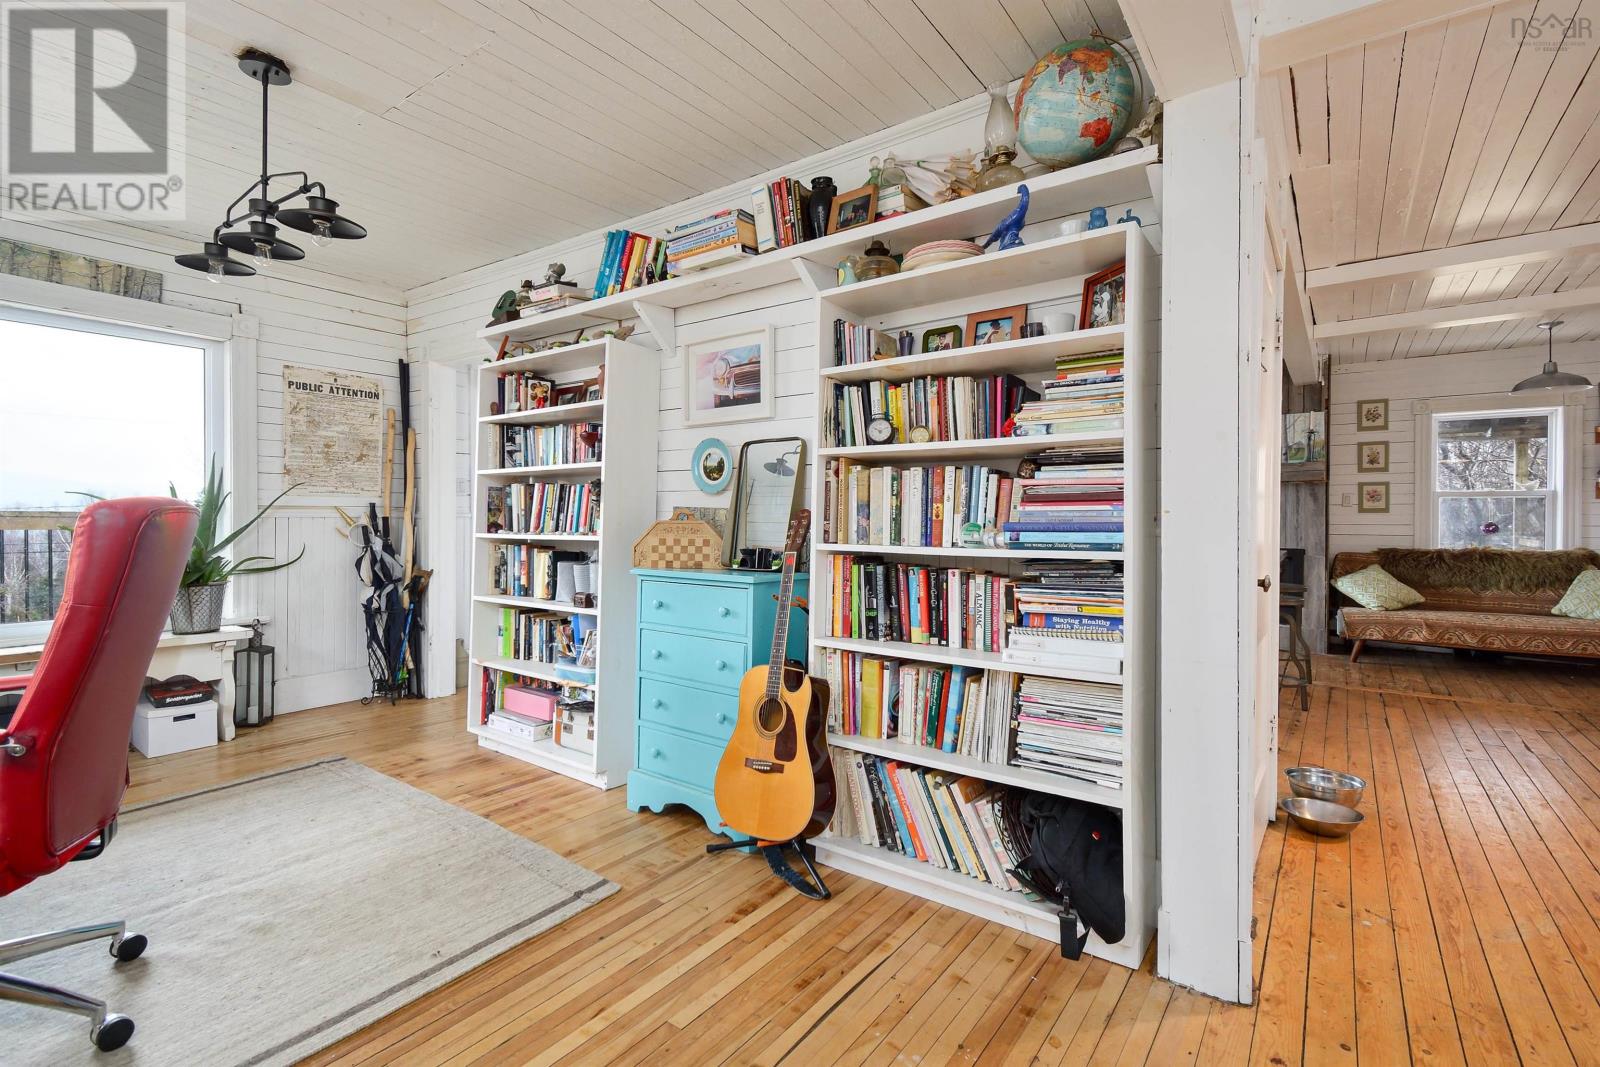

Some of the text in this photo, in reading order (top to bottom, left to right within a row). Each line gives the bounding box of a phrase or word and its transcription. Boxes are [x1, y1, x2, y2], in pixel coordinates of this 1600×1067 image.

[288, 380, 380, 400] PUBLIC ATTENTION
[975, 592, 984, 629] ALMANAC
[1052, 616, 1110, 626] Staying Healthy
